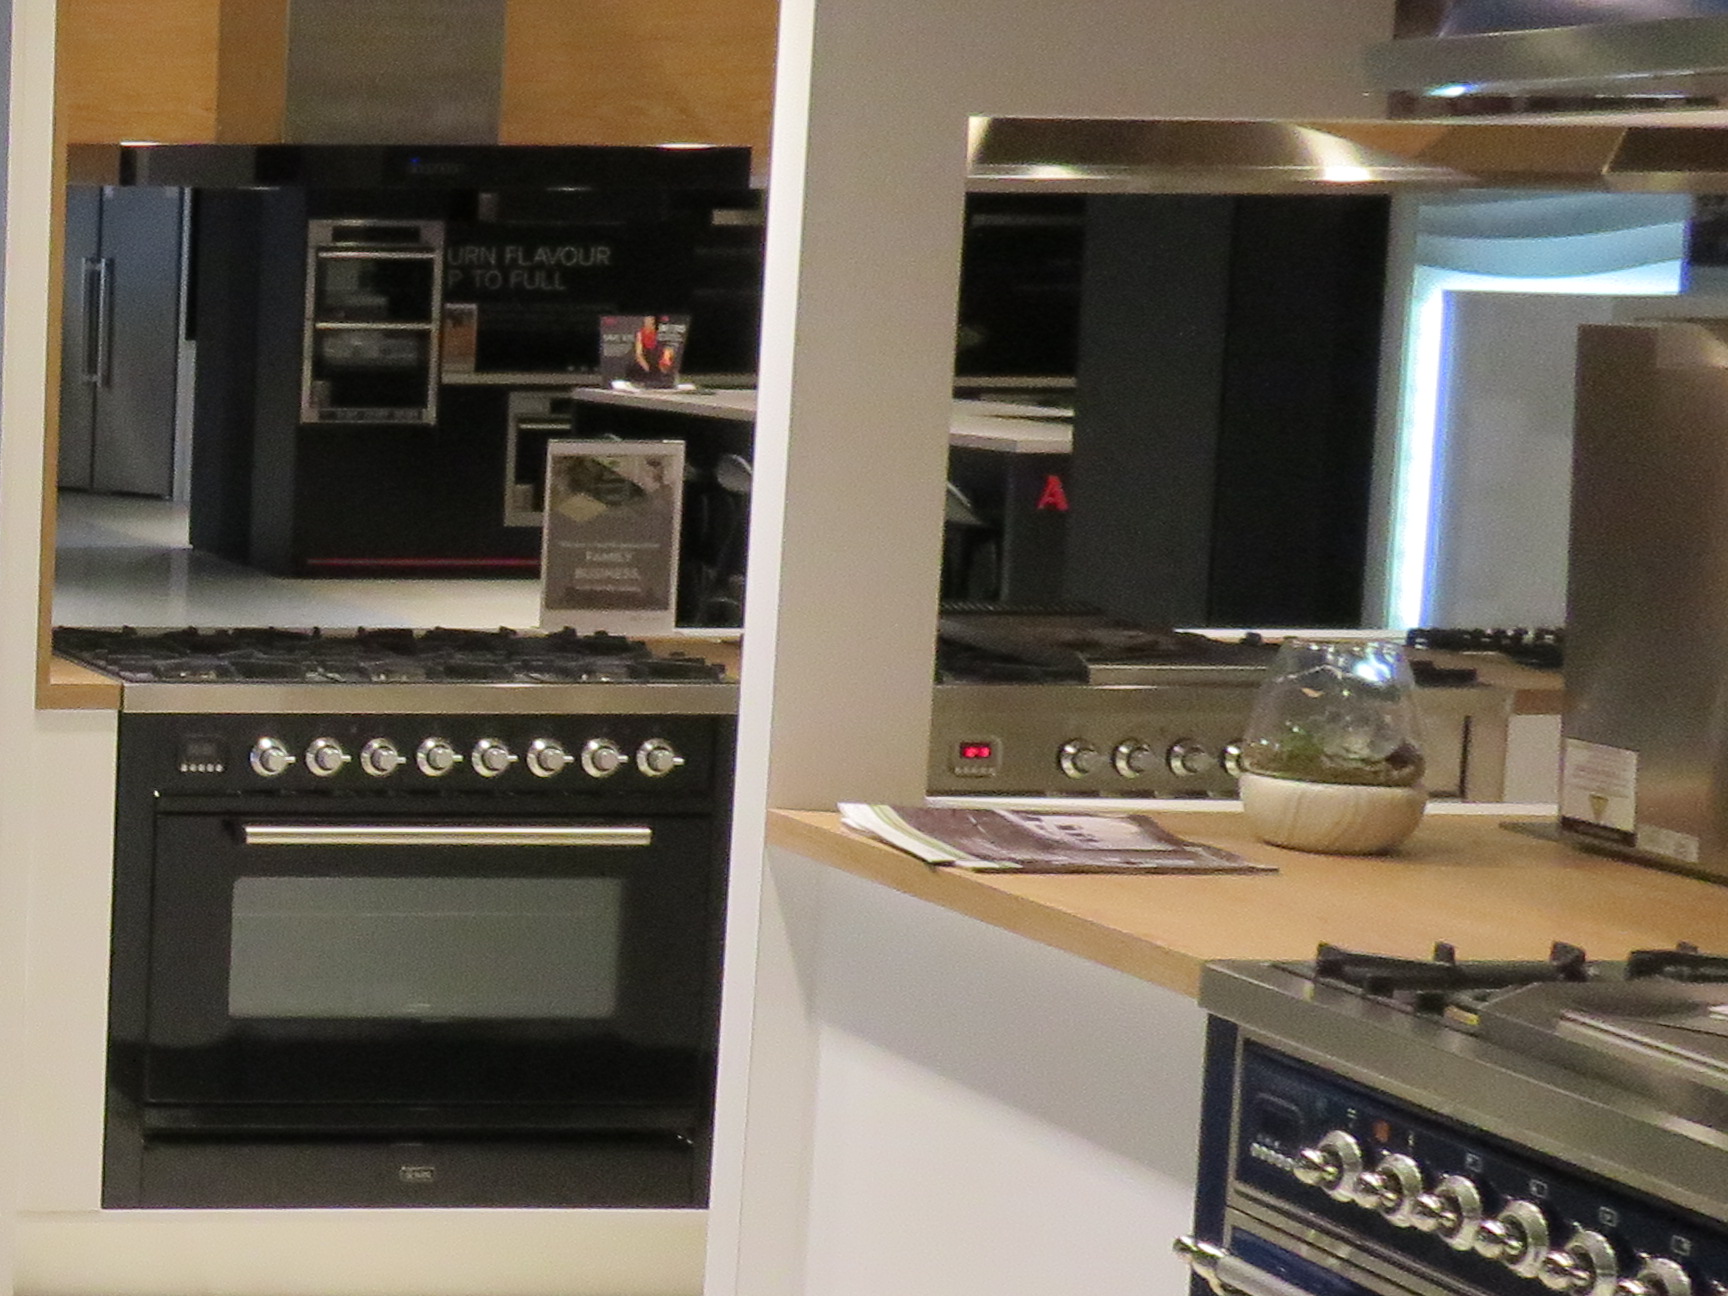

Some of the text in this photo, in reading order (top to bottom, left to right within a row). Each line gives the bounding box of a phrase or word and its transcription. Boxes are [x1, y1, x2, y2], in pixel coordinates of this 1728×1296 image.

[505, 246, 611, 266] FLAVOUR
[475, 270, 502, 290] TO
[511, 271, 567, 290] FULL
[1037, 475, 1069, 512] A
